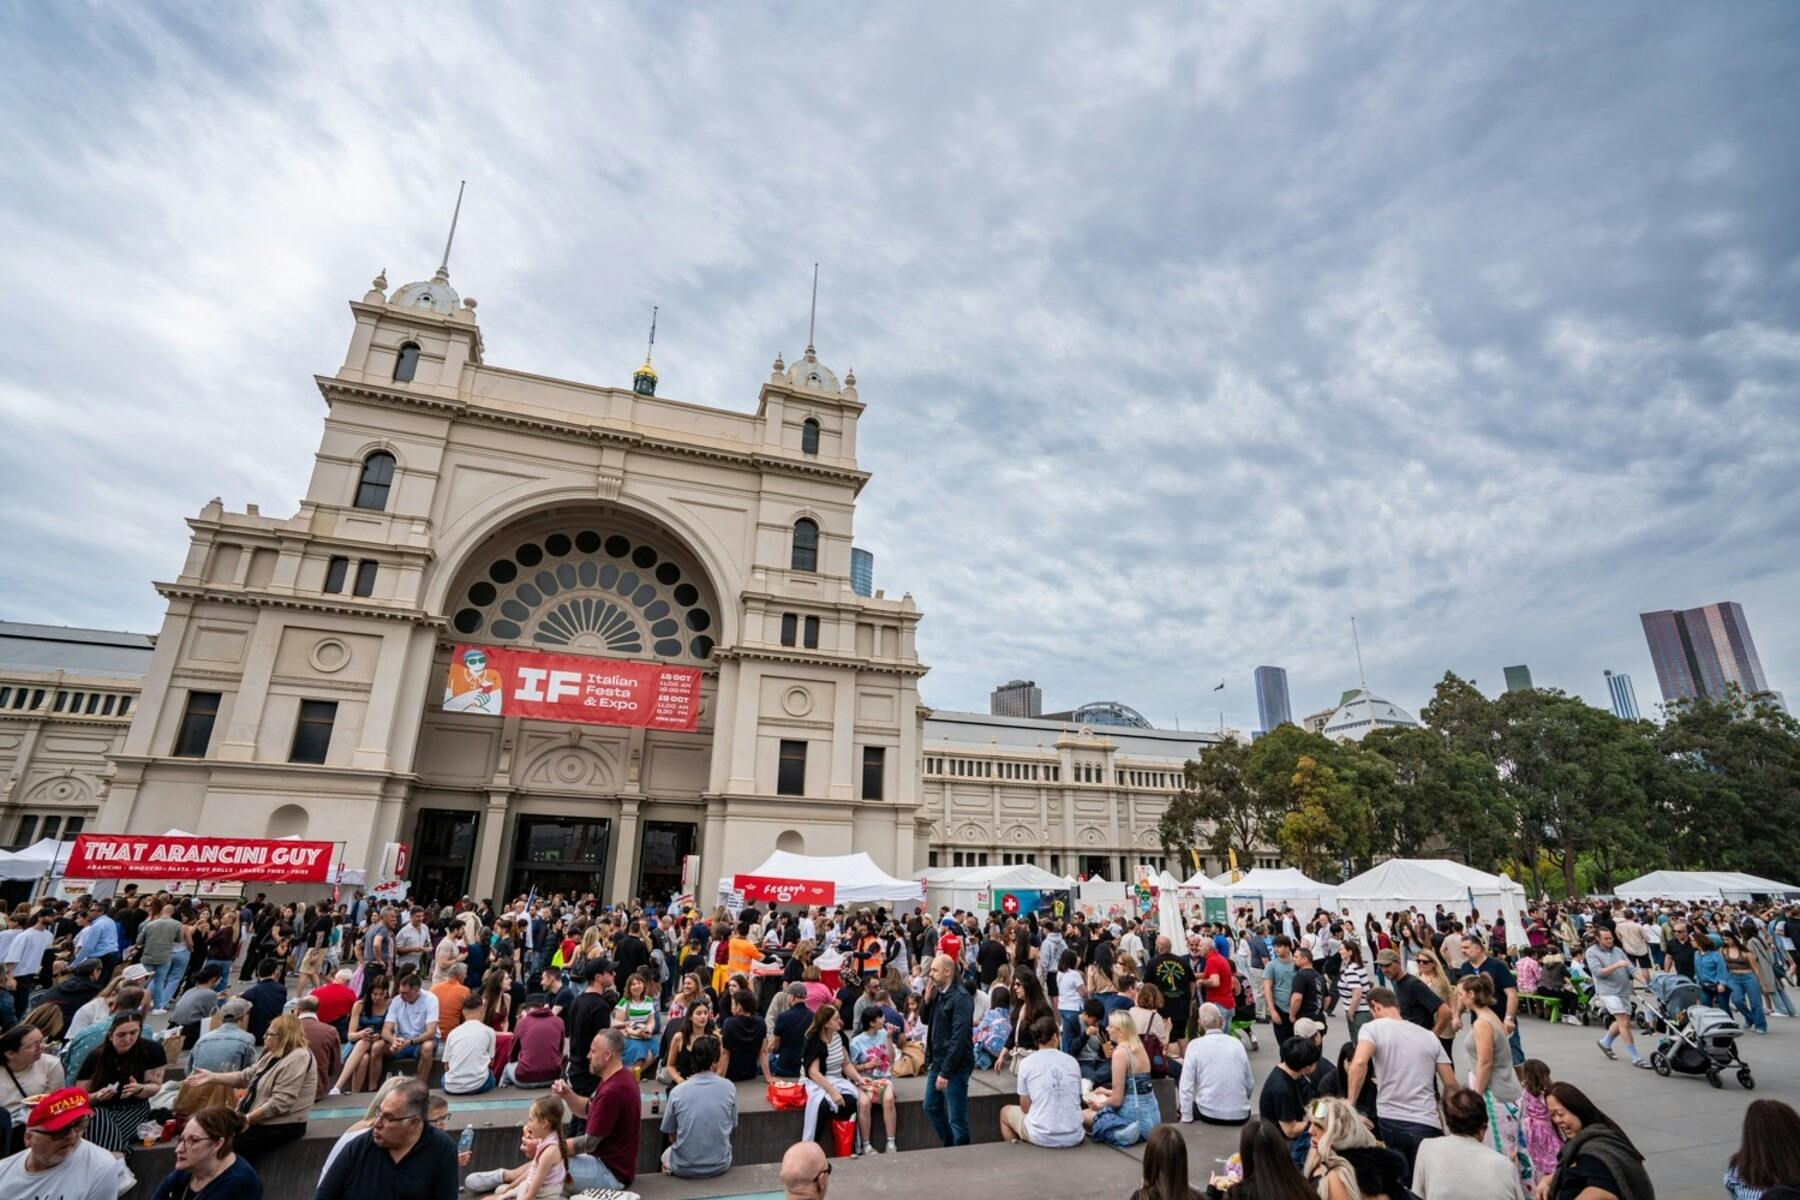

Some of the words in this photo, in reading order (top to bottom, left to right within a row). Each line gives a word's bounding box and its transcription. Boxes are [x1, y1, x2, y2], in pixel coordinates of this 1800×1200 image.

[514, 667, 582, 703] IF
[587, 673, 638, 688] Italian
[673, 674, 691, 682] OCT
[585, 685, 632, 699] Festa
[670, 695, 689, 703] OCT
[583, 697, 596, 707] &
[599, 698, 638, 712] Expo
[84, 842, 148, 861] THAT
[148, 844, 268, 864] ARANCINI
[271, 847, 322, 866] GUY
[49, 1094, 87, 1114] ITALIA
